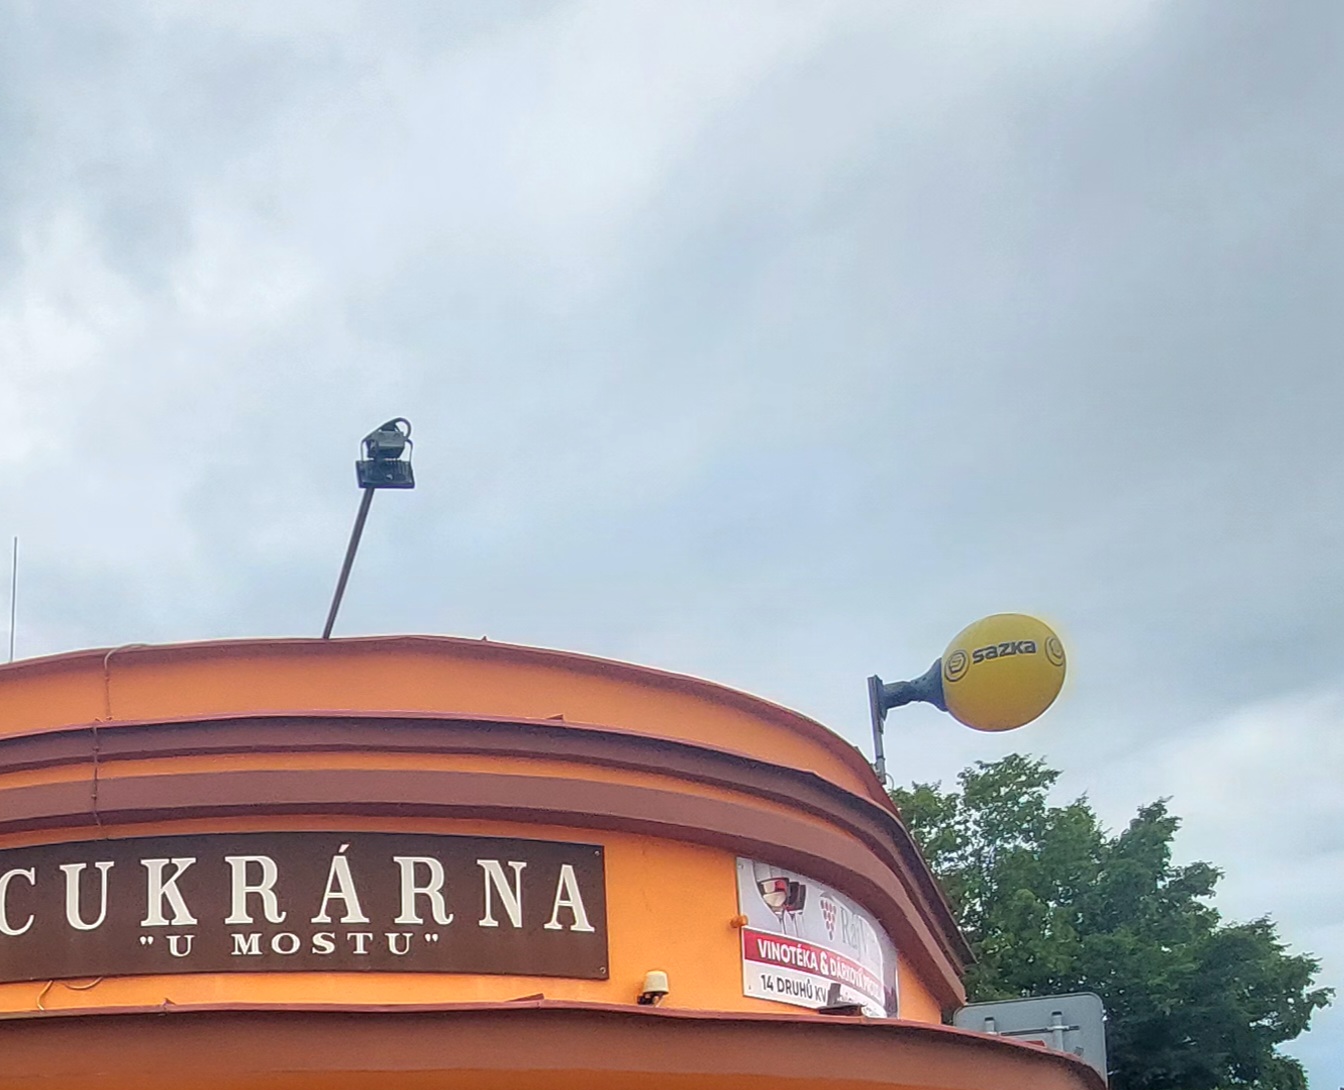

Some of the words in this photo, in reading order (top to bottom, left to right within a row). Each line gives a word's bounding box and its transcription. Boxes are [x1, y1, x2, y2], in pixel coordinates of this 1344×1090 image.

[972, 641, 1036, 664] sazka
[139, 932, 194, 957] "U
[231, 931, 440, 956] MOSTU"
[757, 938, 819, 971] VINOTÉKA
[819, 951, 829, 976] &
[760, 974, 774, 991] 14
[777, 976, 813, 1000] DRUHŮ
